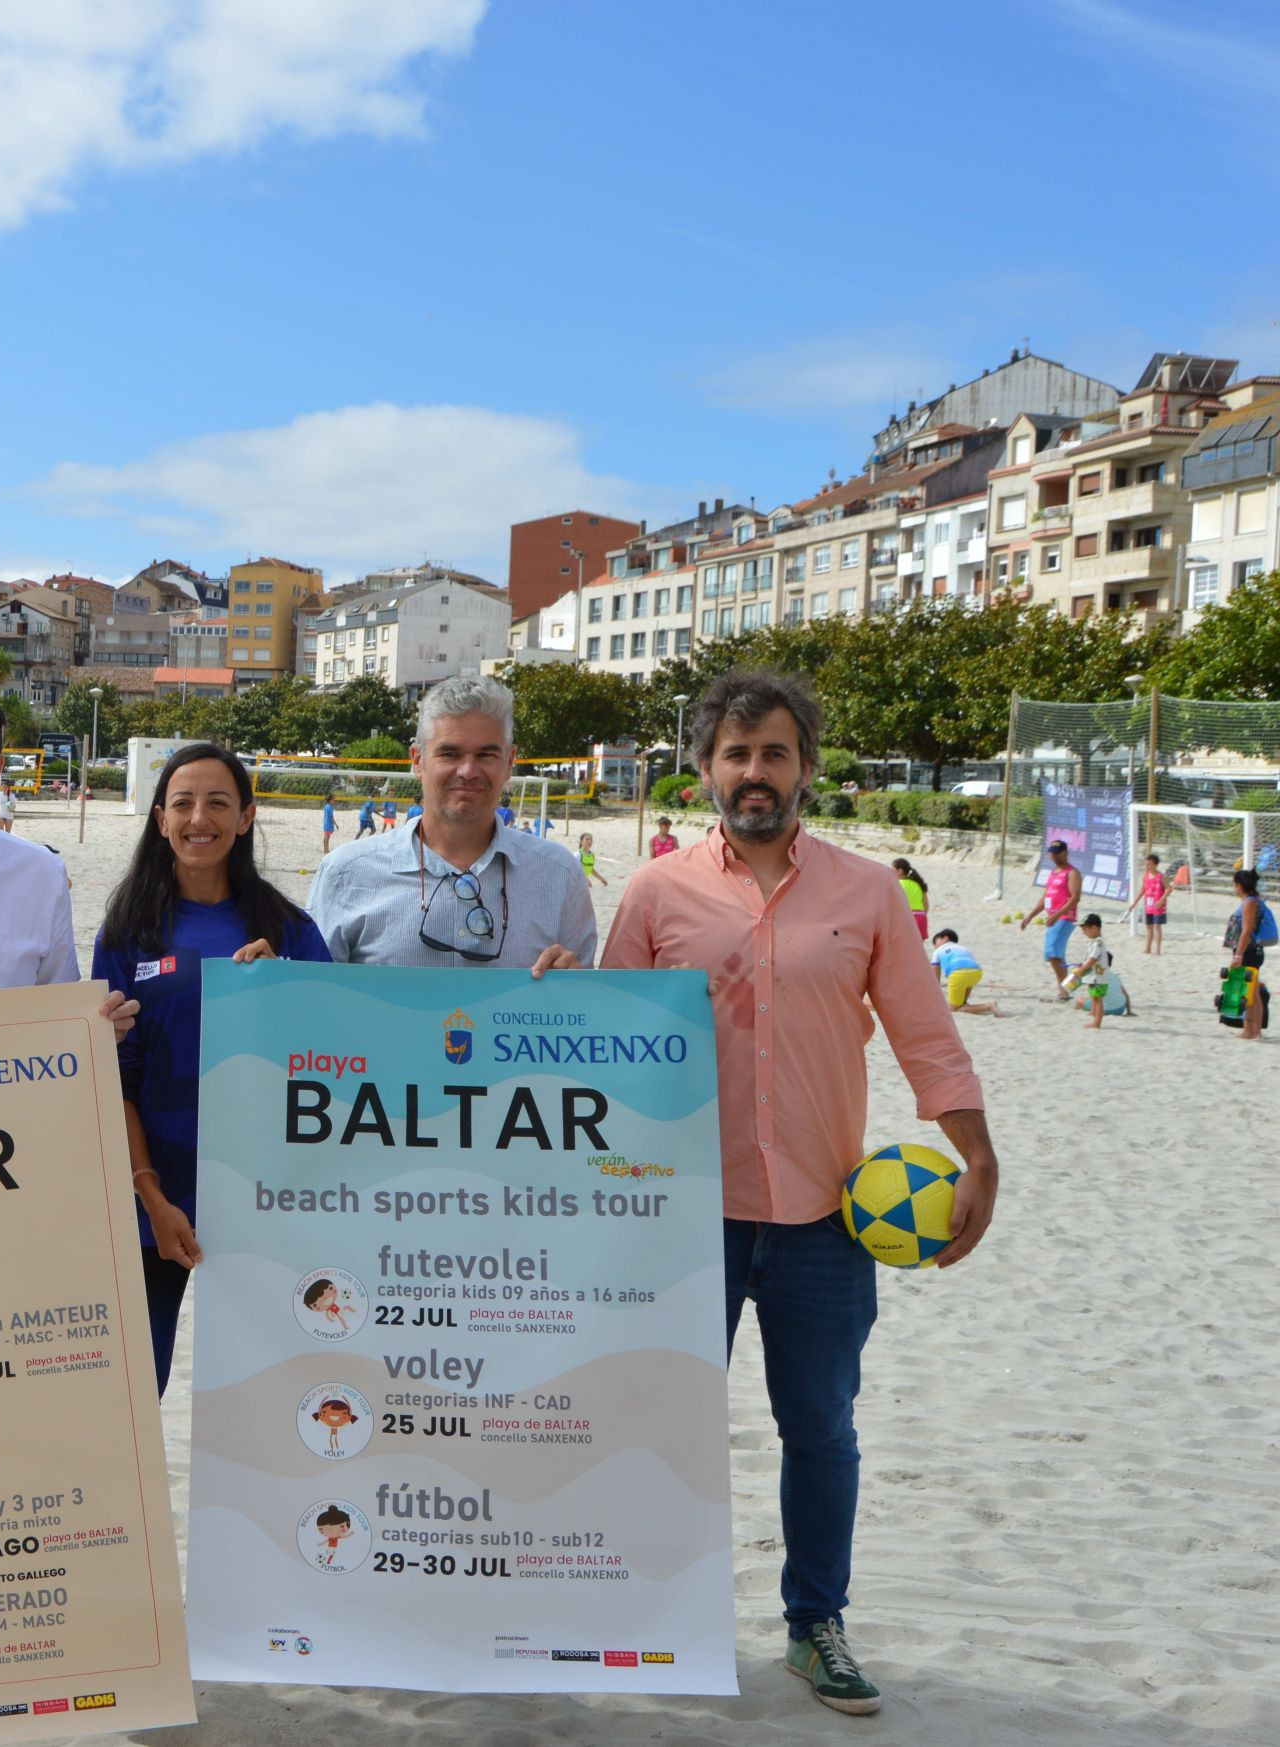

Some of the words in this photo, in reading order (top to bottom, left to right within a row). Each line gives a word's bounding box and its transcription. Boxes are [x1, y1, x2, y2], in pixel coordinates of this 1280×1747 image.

[493, 1012, 564, 1026] CONCELLO
[568, 1014, 586, 1026] DE
[493, 1034, 687, 1064] SANXENXO
[288, 1049, 366, 1079] playa
[285, 1080, 610, 1151] BALTAR
[586, 1153, 625, 1167] verán
[256, 1181, 359, 1213] beach
[374, 1186, 490, 1221] sports
[503, 1186, 579, 1217] kids
[592, 1189, 667, 1217] tour
[378, 1245, 548, 1281] futevolei
[377, 1284, 456, 1300] categoria
[462, 1285, 496, 1300] kids
[503, 1286, 523, 1300] 09
[530, 1286, 570, 1302] años
[576, 1291, 585, 1302] a
[593, 1288, 612, 1302] 16
[618, 1288, 655, 1303] años
[11, 1304, 109, 1330] AMATEUR
[375, 1306, 404, 1325] 22
[412, 1308, 458, 1328] JUL
[470, 1308, 504, 1321] playa
[509, 1309, 524, 1320] de
[528, 1310, 573, 1320] BALTAR
[15, 1331, 53, 1345] MASC
[67, 1324, 109, 1340] MIXTA
[468, 1323, 511, 1333] concello
[515, 1324, 576, 1334] SANXENXO
[26, 1356, 52, 1368] playa
[55, 1354, 67, 1363] de
[70, 1351, 102, 1361] BALTAR
[28, 1366, 61, 1376] concello
[64, 1360, 110, 1372] SANXENXO
[383, 1349, 484, 1388] voley
[385, 1392, 478, 1410] categorias
[485, 1394, 514, 1408] INF
[534, 1396, 571, 1410] CAD
[382, 1414, 414, 1434] 25
[423, 1416, 471, 1437] JUL
[482, 1418, 520, 1431] playa
[524, 1419, 540, 1429] de
[545, 1420, 589, 1430] BALTAR
[481, 1432, 526, 1443] concello
[531, 1434, 592, 1444] SANXENXO
[13, 1495, 24, 1512] 3
[32, 1492, 64, 1514] por
[72, 1488, 83, 1505] 3
[375, 1483, 492, 1521] fútbol
[23, 1514, 61, 1529] mixto
[43, 1532, 71, 1545] playa
[73, 1530, 86, 1540] de
[89, 1527, 124, 1538] BALTAR
[44, 1541, 79, 1553] concello
[82, 1536, 128, 1549] SANXENXO
[382, 1528, 473, 1547] categorias
[481, 1531, 533, 1546] sub10
[552, 1533, 603, 1547] sub12
[373, 1552, 456, 1576] 29-30
[464, 1558, 511, 1578] JUL
[517, 1554, 553, 1567] playa
[557, 1554, 573, 1565] de
[577, 1555, 622, 1566] BALTAR
[18, 1568, 66, 1581] GALLEGO
[519, 1569, 564, 1579] concello
[569, 1569, 628, 1580] SANXENXO
[23, 1613, 65, 1629] MASC
[4, 1644, 17, 1653] de
[20, 1640, 56, 1651] BALTAR
[14, 1650, 64, 1662] SANXENXO
[643, 1653, 672, 1662] GADIS
[76, 1694, 114, 1708] GADIS
